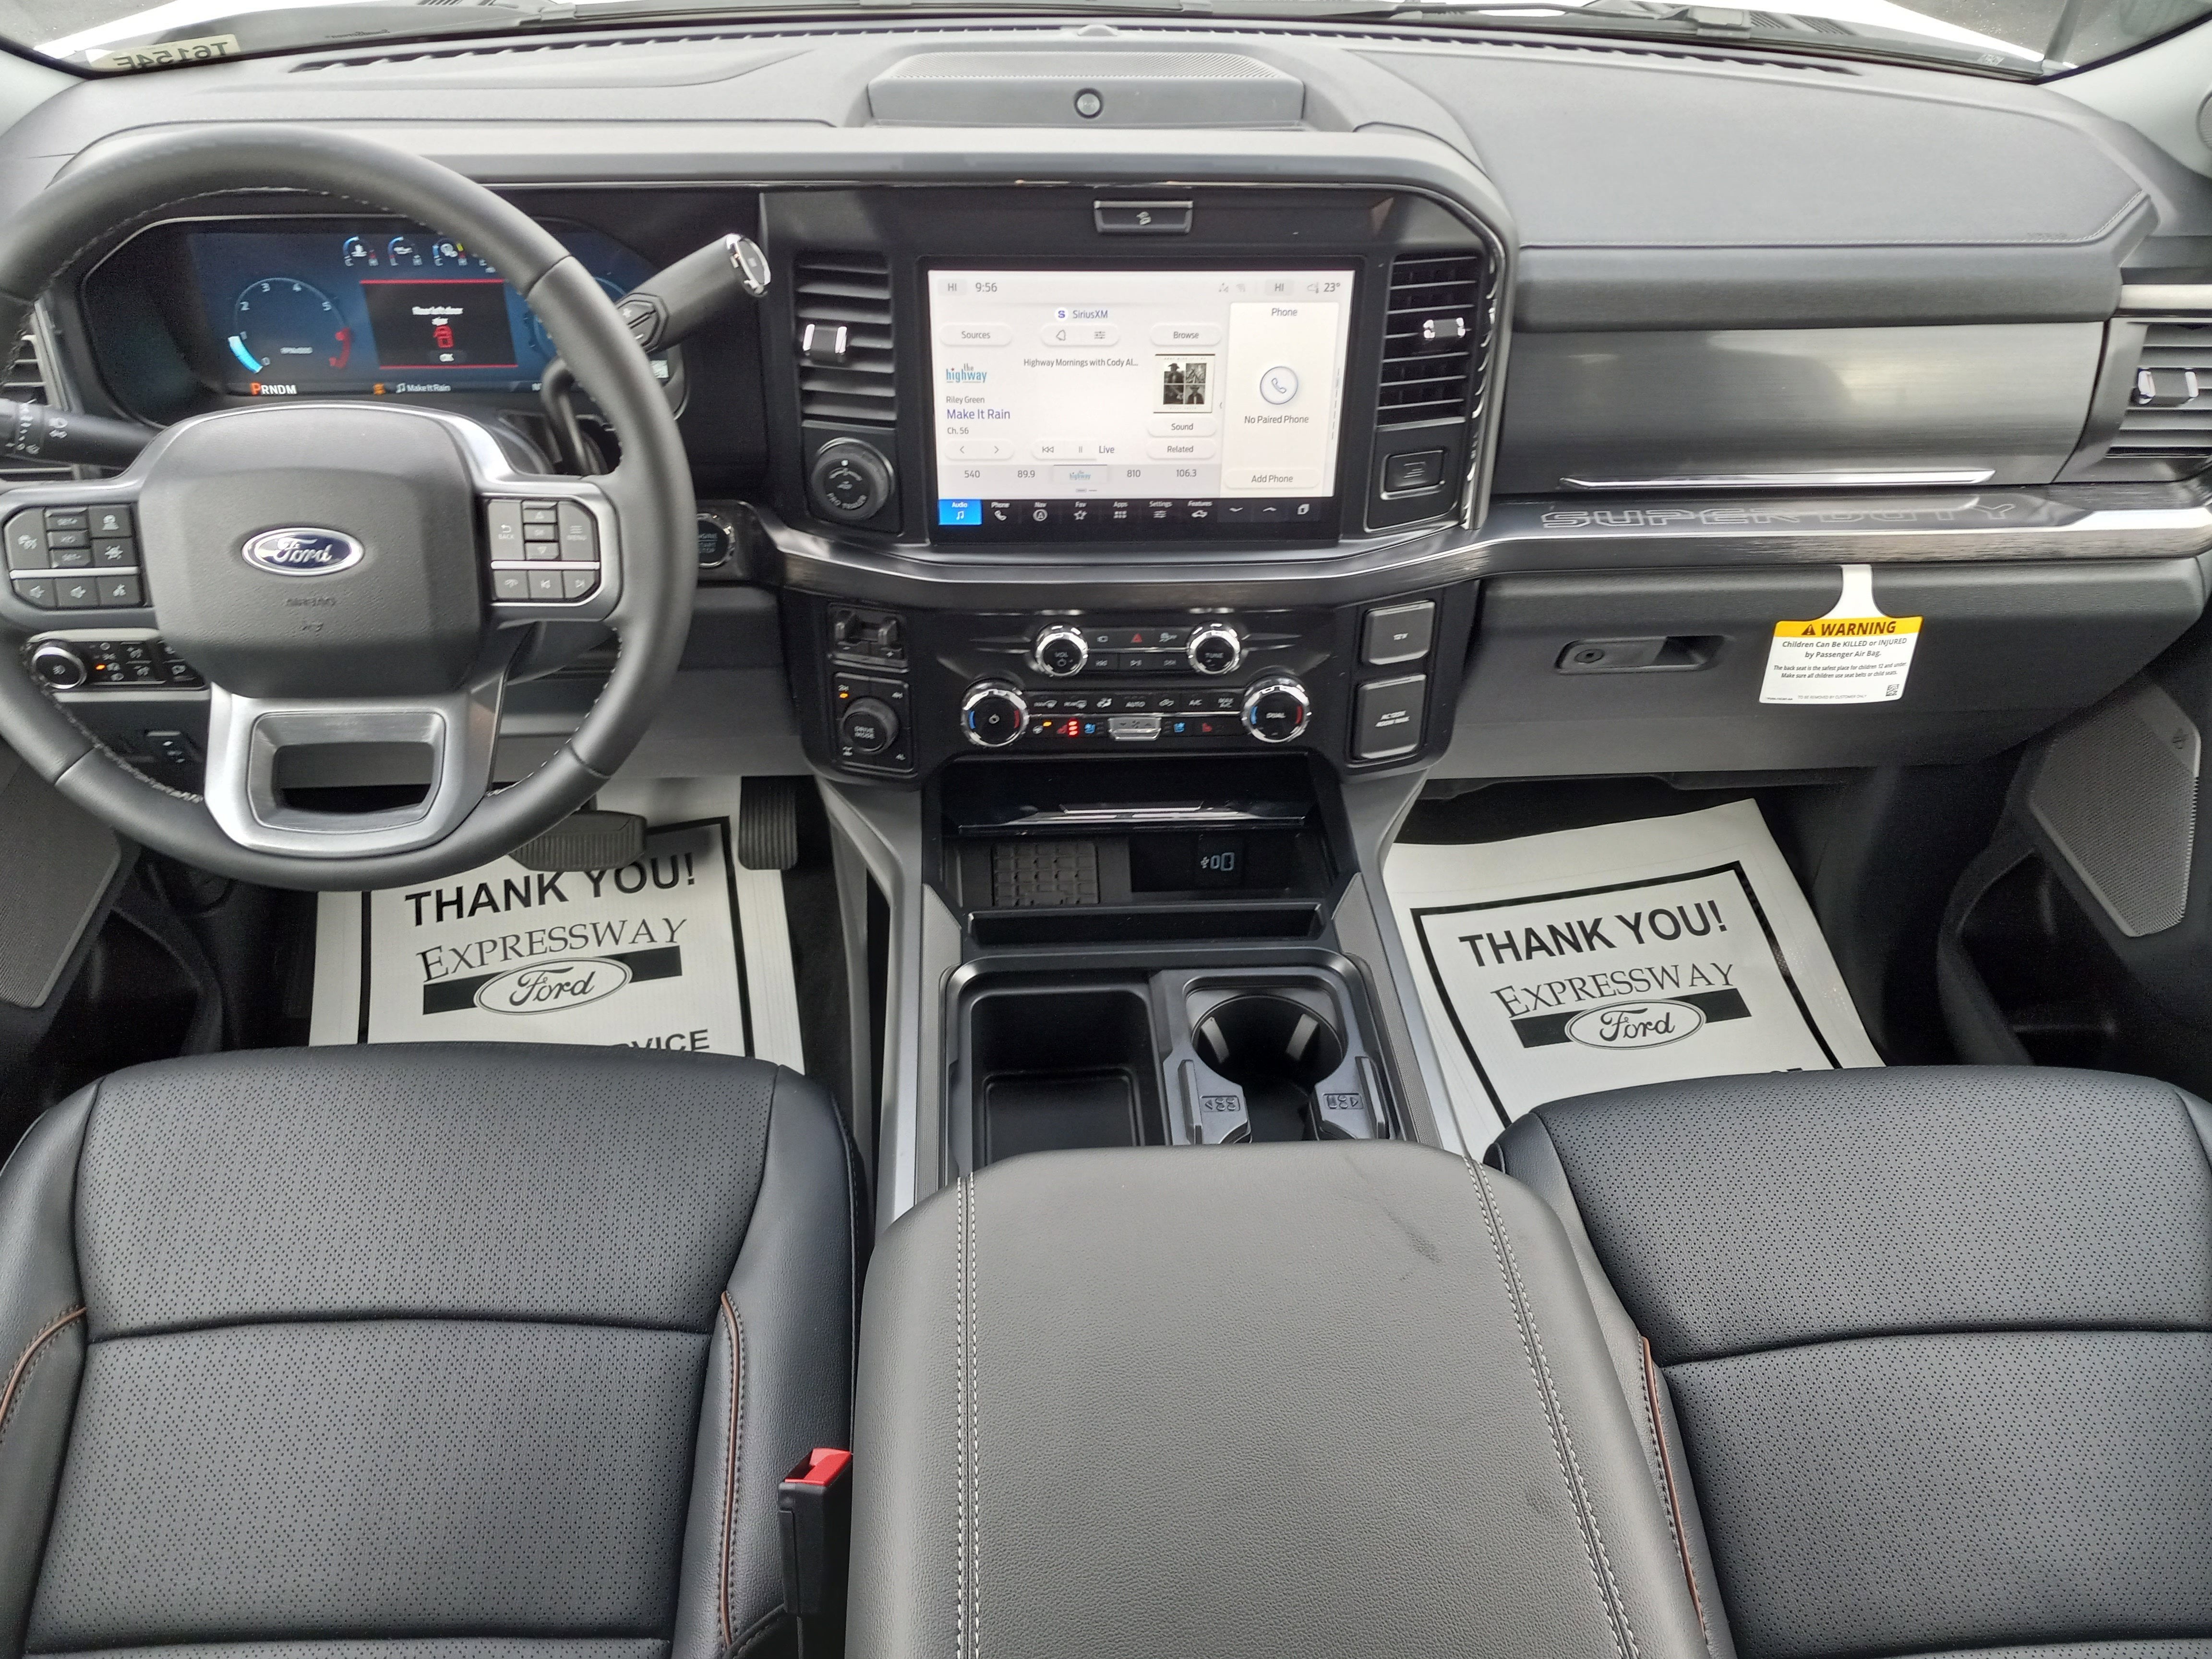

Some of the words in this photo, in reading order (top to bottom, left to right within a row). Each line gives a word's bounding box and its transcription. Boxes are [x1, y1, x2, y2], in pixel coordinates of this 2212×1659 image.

[947, 283, 957, 292] HI
[975, 282, 998, 292] 9:56
[1274, 283, 1285, 292] HI
[1072, 310, 1108, 319] SiriusXM
[1271, 308, 1298, 317] Phone
[961, 330, 991, 339] Sources
[1173, 331, 1199, 339] Browse
[963, 363, 974, 371] the
[1023, 358, 1055, 368] Highway
[1056, 358, 1088, 368] Mornings
[1090, 358, 1106, 366] with
[1106, 359, 1125, 367] Cody
[946, 369, 987, 383] highway
[946, 396, 963, 405] Riley
[964, 396, 985, 404] Green
[947, 409, 975, 420] Make
[977, 409, 985, 420] It
[987, 409, 1011, 420] Rain
[1244, 415, 1256, 424] No
[1257, 415, 1282, 424] Paired
[1283, 415, 1309, 423] Phone
[1098, 445, 1115, 454] Live
[964, 470, 980, 478] 540
[1017, 469, 1035, 478] 89.9
[1127, 469, 1141, 478] 810
[1176, 469, 1197, 477] 106.3
[1540, 507, 1801, 529] SUPER
[272, 537, 334, 564] Ford
[1821, 621, 1897, 637] WARNING
[1878, 637, 1907, 647] INJURED
[1804, 651, 1814, 659] by
[404, 870, 570, 927] THANK
[584, 852, 696, 899] YOU!
[1458, 917, 1617, 968] THANK
[1614, 899, 1728, 945] YOU!
[416, 917, 687, 983] EXPRESSWAY
[509, 967, 596, 1006] Ford
[1490, 962, 1736, 1019] EXPRESSWAY
[1599, 1007, 1676, 1042] Ford
